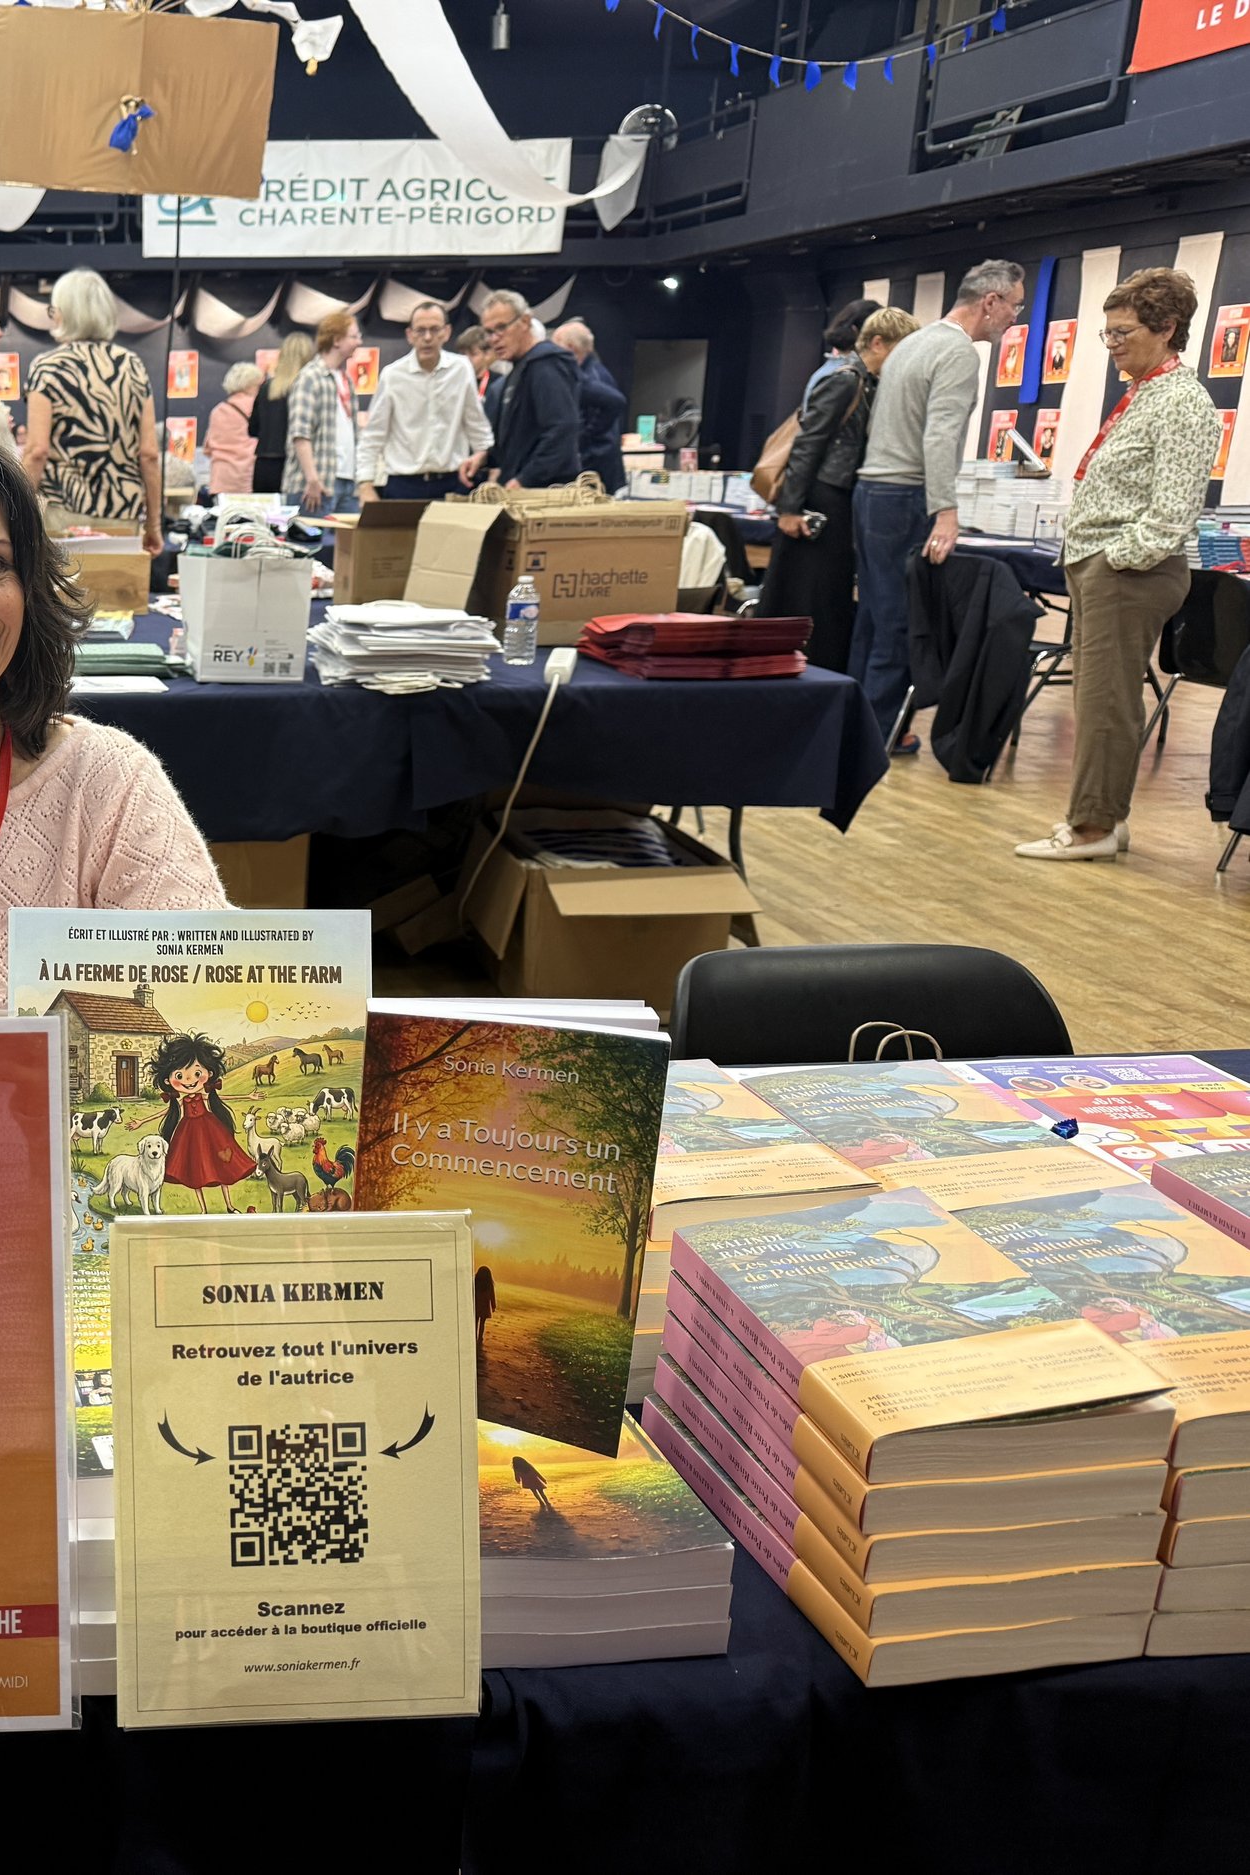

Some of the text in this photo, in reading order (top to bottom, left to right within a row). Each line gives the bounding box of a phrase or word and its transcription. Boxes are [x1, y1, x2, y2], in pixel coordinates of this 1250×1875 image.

[1196, 2, 1224, 31] LE
[264, 173, 369, 202] RÉDIT
[238, 203, 556, 227] CHARENTE-PÉRIGORD
[581, 567, 648, 585] hachette
[579, 586, 611, 598] LIVRE
[213, 649, 244, 662] REY
[68, 925, 93, 940] ÉCRIT
[96, 929, 106, 940] ET
[108, 927, 149, 941] ILLUSTRÉ
[152, 930, 169, 941] PAR
[177, 930, 217, 942] WRITTEN
[220, 930, 238, 942] AND
[241, 930, 299, 942] ILLUSTRATED
[303, 930, 313, 942] BY
[156, 944, 224, 956] SONIA KERMEN
[39, 959, 342, 984] À LA FERME DE ROSE / ROSE AT THE FARM
[444, 1055, 579, 1084] Sonia Kermen
[392, 1112, 620, 1161] Il y a Toujours un
[391, 1143, 617, 1195] Commencement
[712, 1234, 786, 1250] KALINDI
[719, 1242, 806, 1260] RAMPHUL
[732, 1249, 856, 1272] Les solitudes
[745, 1253, 900, 1283] de Petite Rivière
[202, 1281, 384, 1304] SONIA KERMEN
[751, 1283, 779, 1291] roman
[172, 1340, 418, 1359] Retrouvez tout l'univers
[238, 1369, 354, 1387] de l'autrice
[258, 1601, 345, 1618] Scannez
[175, 1619, 426, 1641] pour accéder à la boutique officielle
[244, 1658, 360, 1673] www.soniakermen.fr
